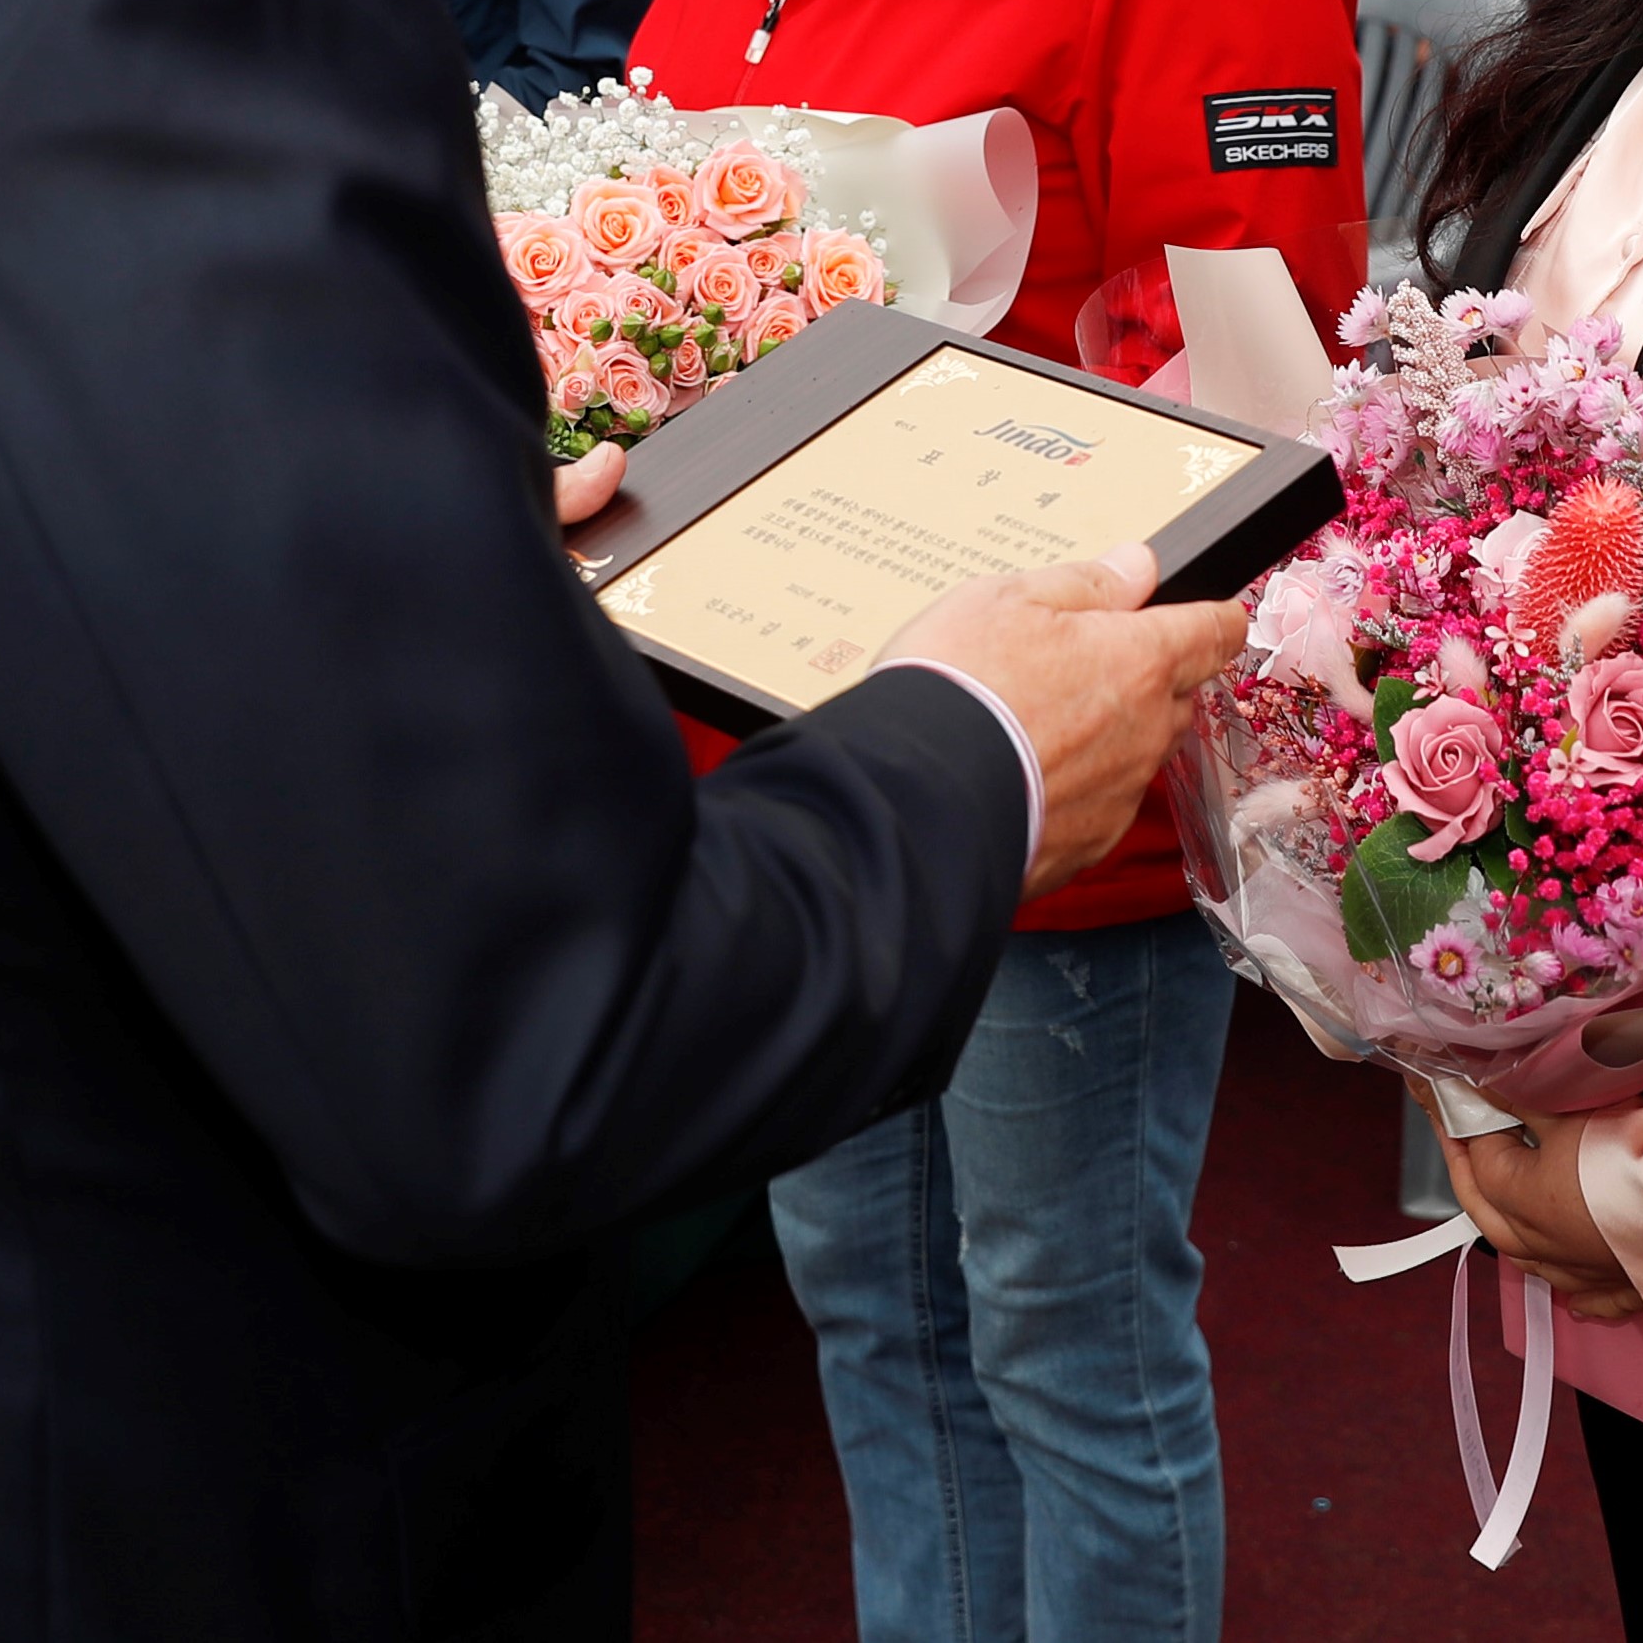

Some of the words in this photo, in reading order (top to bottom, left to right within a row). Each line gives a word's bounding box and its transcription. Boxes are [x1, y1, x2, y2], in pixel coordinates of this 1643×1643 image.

[1215, 104, 1332, 132] SKX
[1224, 143, 1330, 163] SKECHERS
[973, 419, 1074, 460] Jindo
